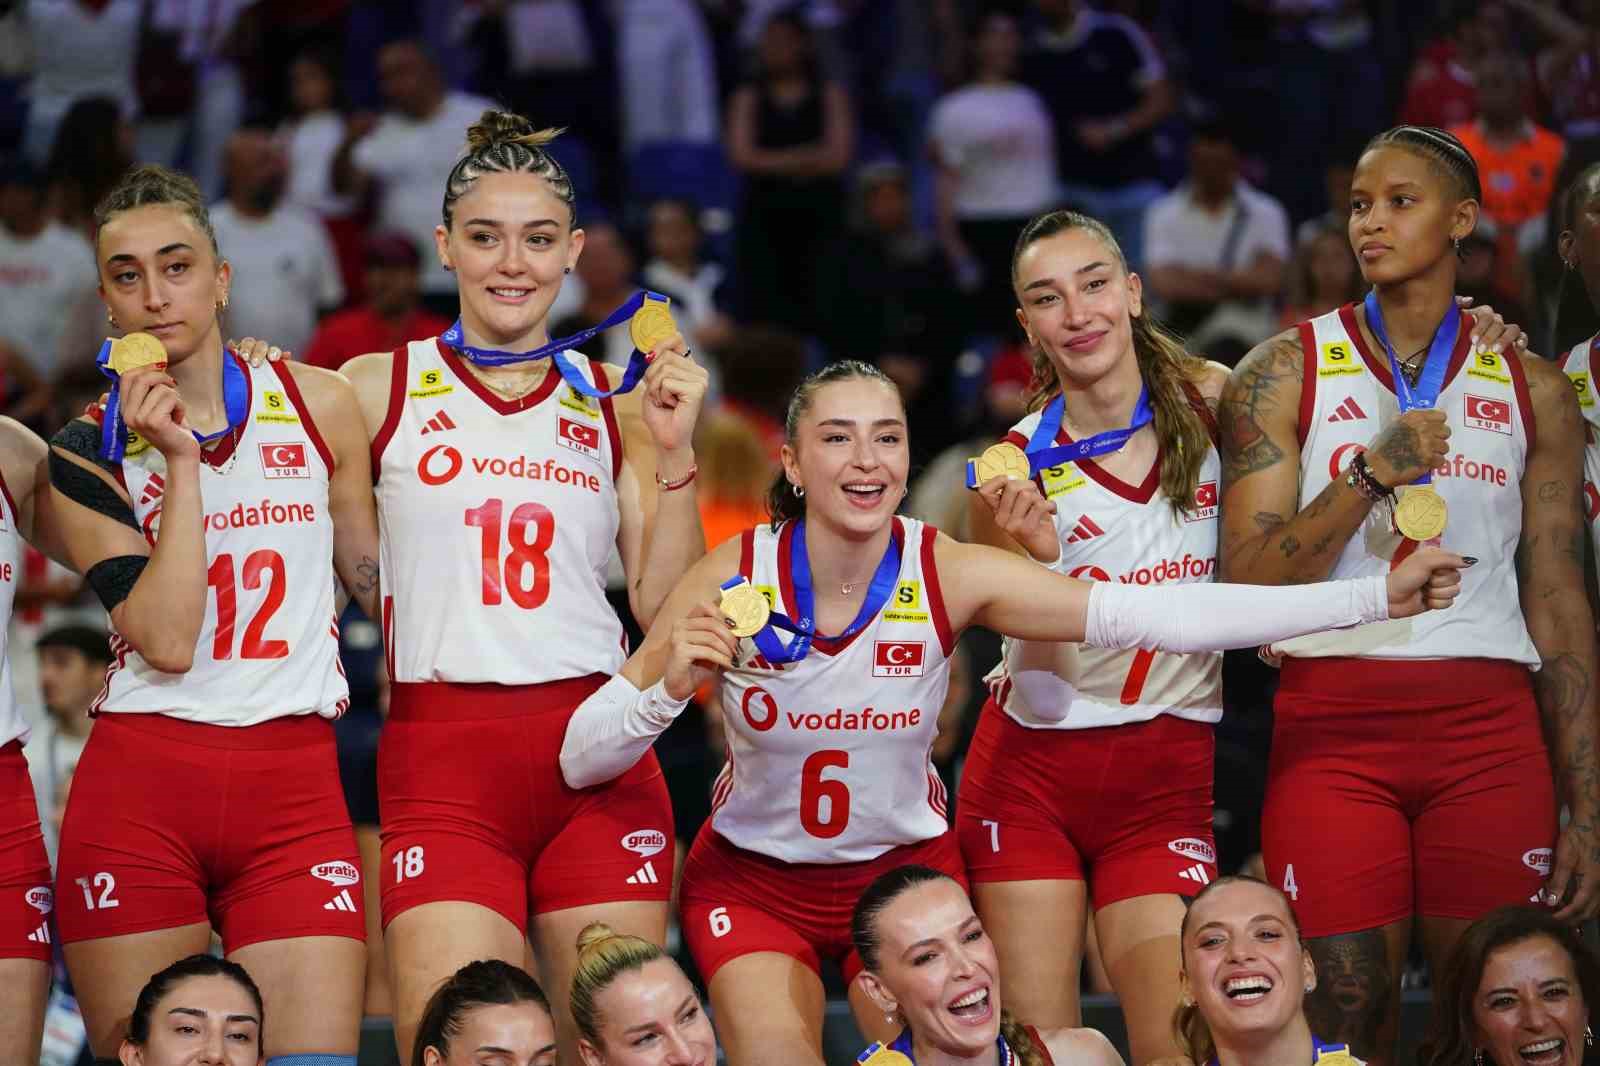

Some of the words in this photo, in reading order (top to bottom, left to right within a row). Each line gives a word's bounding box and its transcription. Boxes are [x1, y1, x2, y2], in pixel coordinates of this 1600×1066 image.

[1330, 347, 1345, 361] S
[426, 372, 438, 384] S
[269, 394, 280, 408] S
[1476, 421, 1502, 431] TUR
[567, 440, 591, 455] TUR
[274, 467, 300, 477] TUR
[472, 455, 602, 493] vodafone
[465, 498, 556, 610] 18
[1119, 553, 1217, 585] vodafon
[207, 549, 290, 661] 12
[899, 586, 914, 604] S
[886, 666, 912, 675] TUR
[786, 707, 922, 732] vodafone
[799, 749, 851, 839] 6
[627, 832, 665, 848] gratis
[982, 820, 1000, 853] 7
[316, 863, 359, 880] gratis
[393, 845, 425, 884] 18
[75, 871, 120, 910] 12
[1283, 863, 1298, 901] 4
[708, 906, 732, 938] 6
